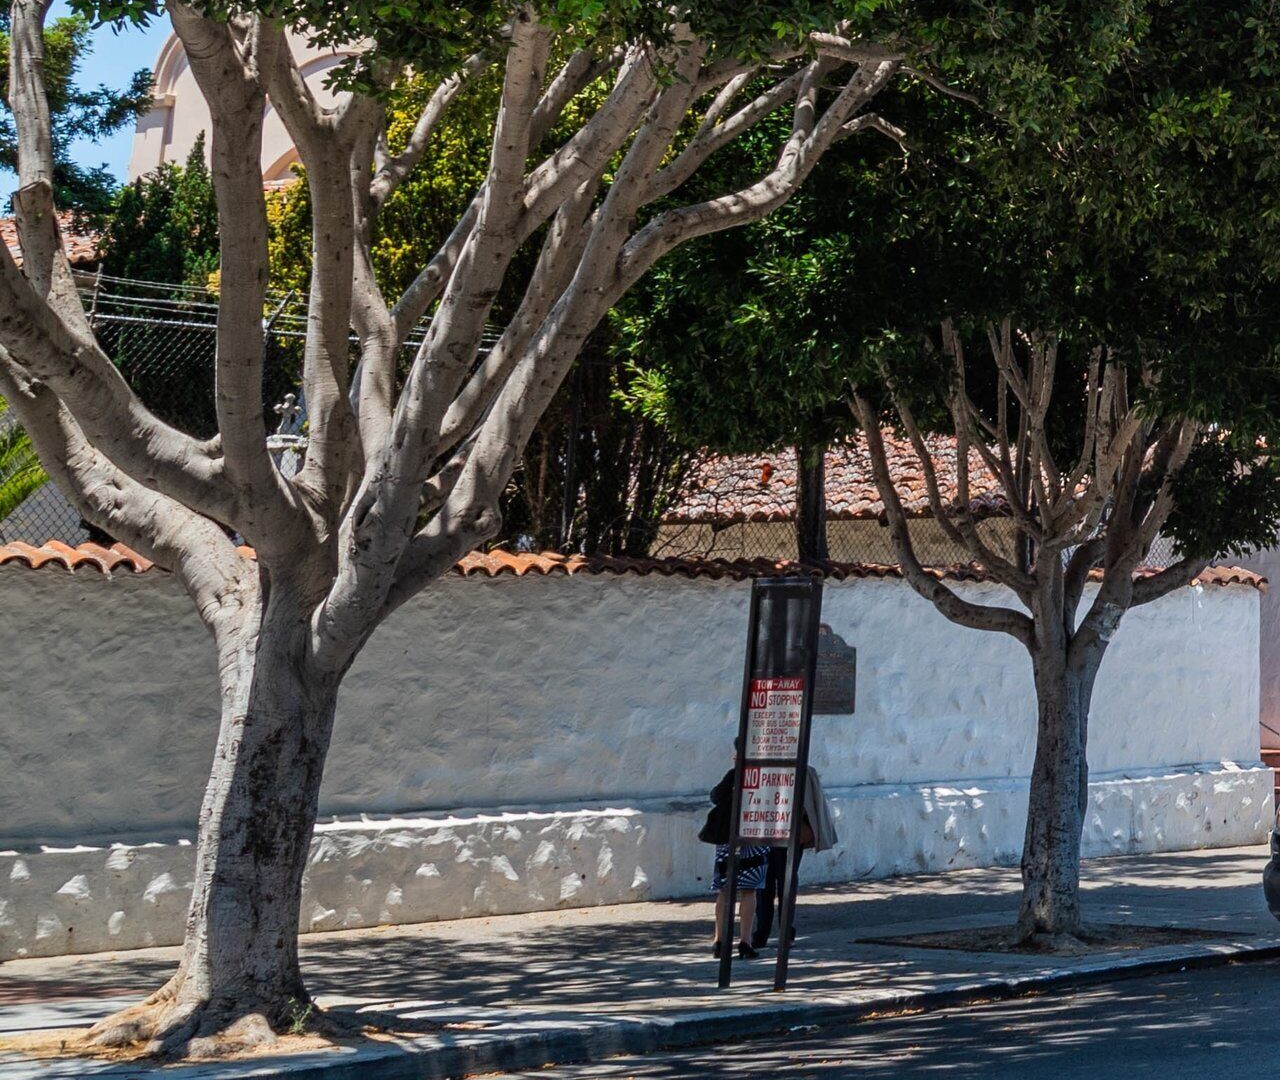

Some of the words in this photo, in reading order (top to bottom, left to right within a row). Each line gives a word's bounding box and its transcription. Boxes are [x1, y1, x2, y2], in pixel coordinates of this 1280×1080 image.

[757, 680, 800, 690] TOW-AWAY
[751, 692, 766, 707] NO
[769, 694, 802, 706] STOPPING
[754, 711, 776, 719] EXCEPT
[744, 769, 759, 787] NO
[762, 773, 794, 787] PARKING
[748, 792, 761, 805] 7AM
[774, 792, 789, 805] 8AM
[743, 811, 791, 823] WEDNESDAY
[764, 828, 790, 836] CLEANING
